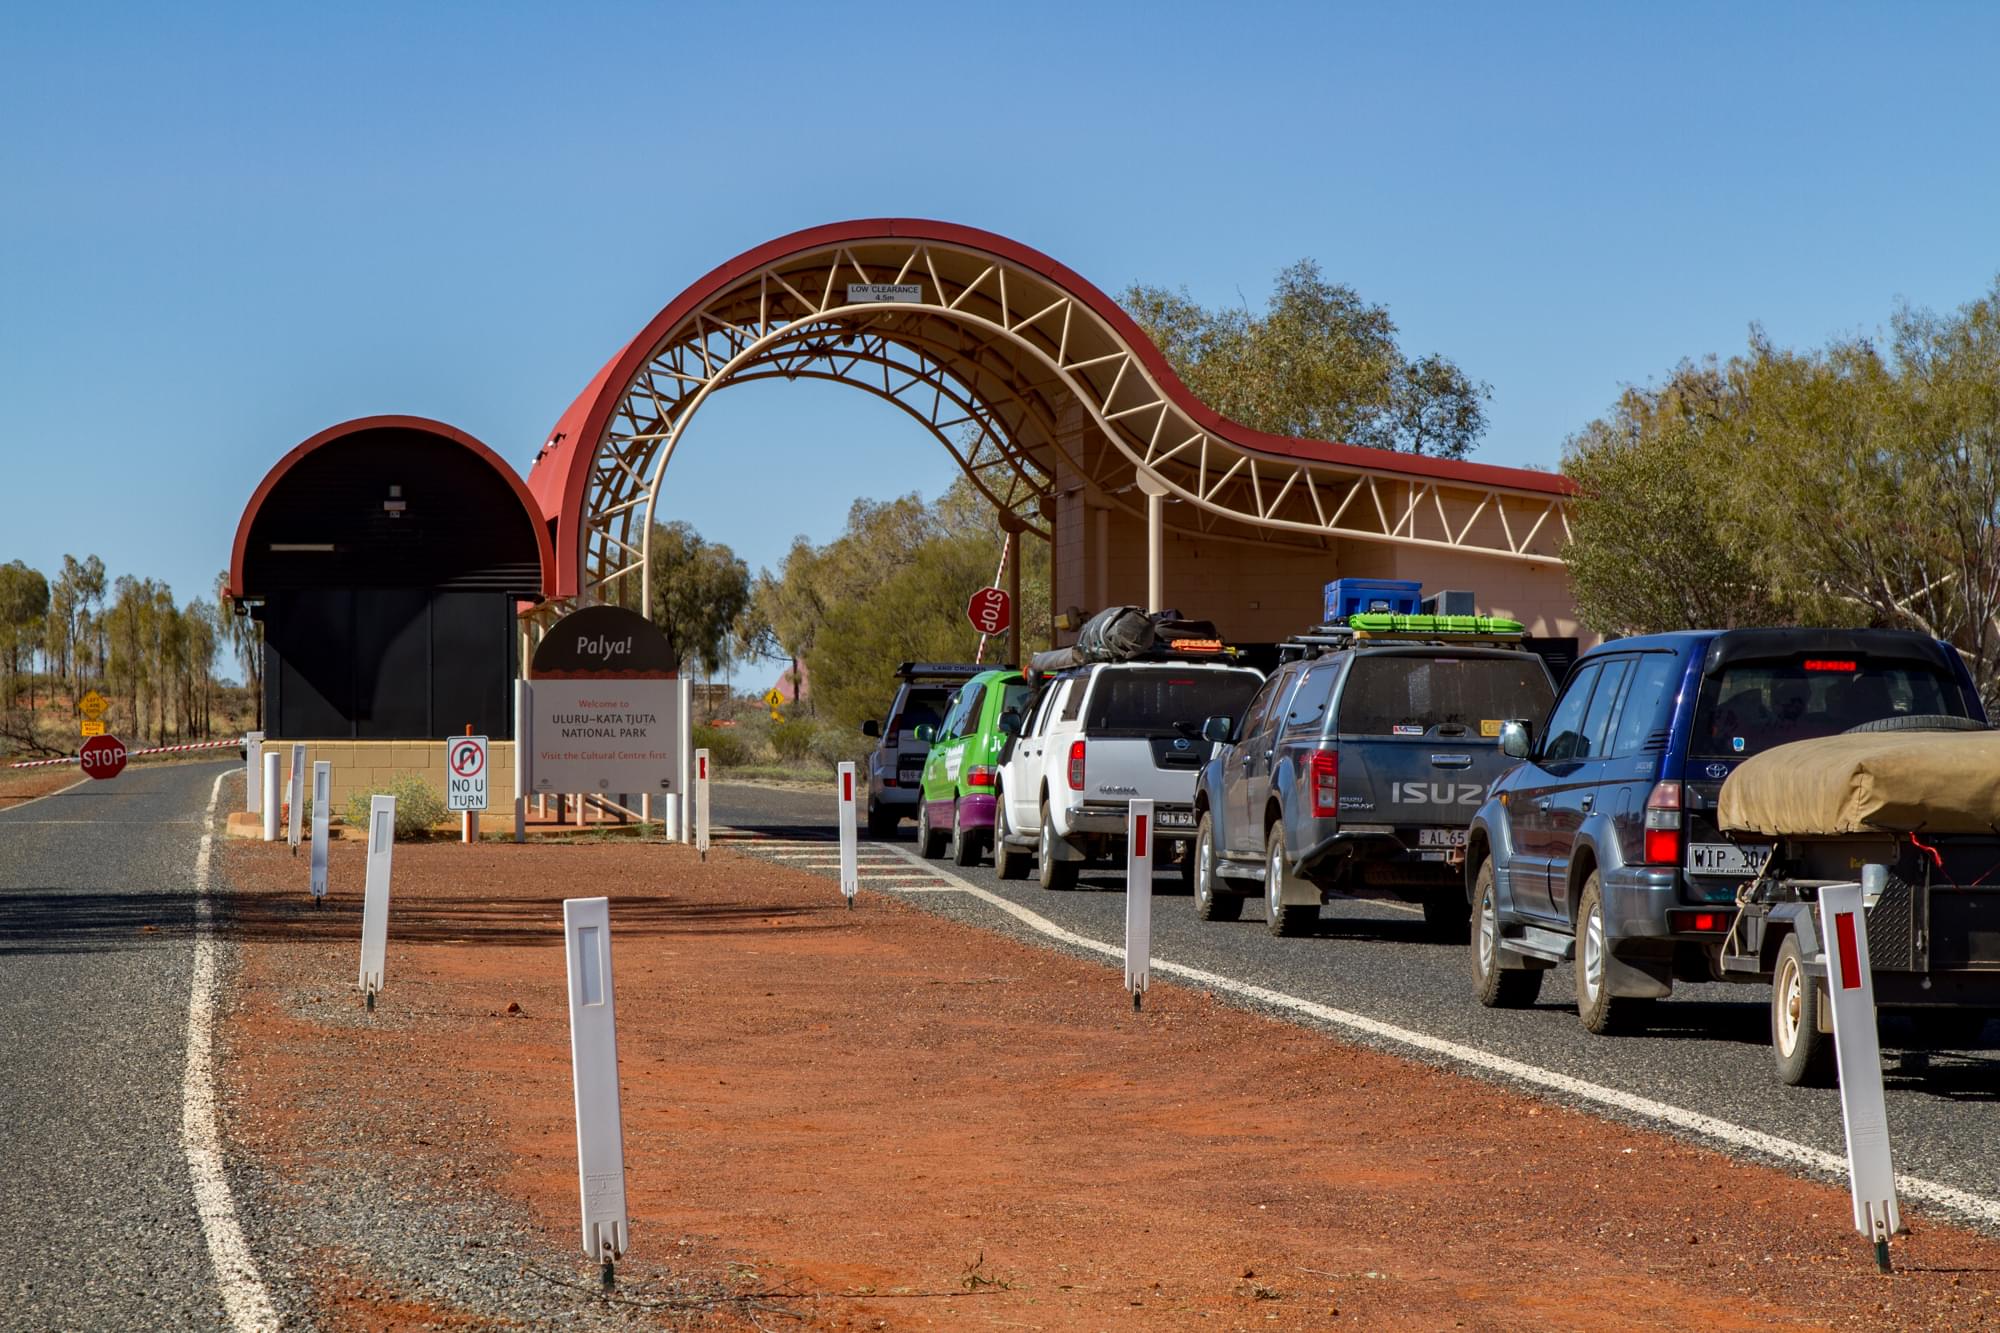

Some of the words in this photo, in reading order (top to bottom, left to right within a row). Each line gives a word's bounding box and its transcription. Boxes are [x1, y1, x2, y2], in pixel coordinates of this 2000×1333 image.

[980, 591, 1003, 631] STOP
[577, 635, 632, 661] Palya!
[579, 700, 617, 708] Welcome
[621, 700, 629, 708] to
[626, 714, 656, 725] TJUTA
[562, 729, 616, 738] NATIONAL
[620, 729, 647, 738] PARK
[83, 748, 124, 768] STOP
[541, 752, 560, 760] Visit
[564, 752, 577, 760] the
[581, 752, 615, 760] Cultural
[618, 752, 646, 760] Centre
[649, 752, 667, 760] first
[452, 779, 470, 792] NO
[475, 779, 483, 792] U
[1392, 782, 1489, 805] ISUZ
[452, 795, 483, 806] TURN
